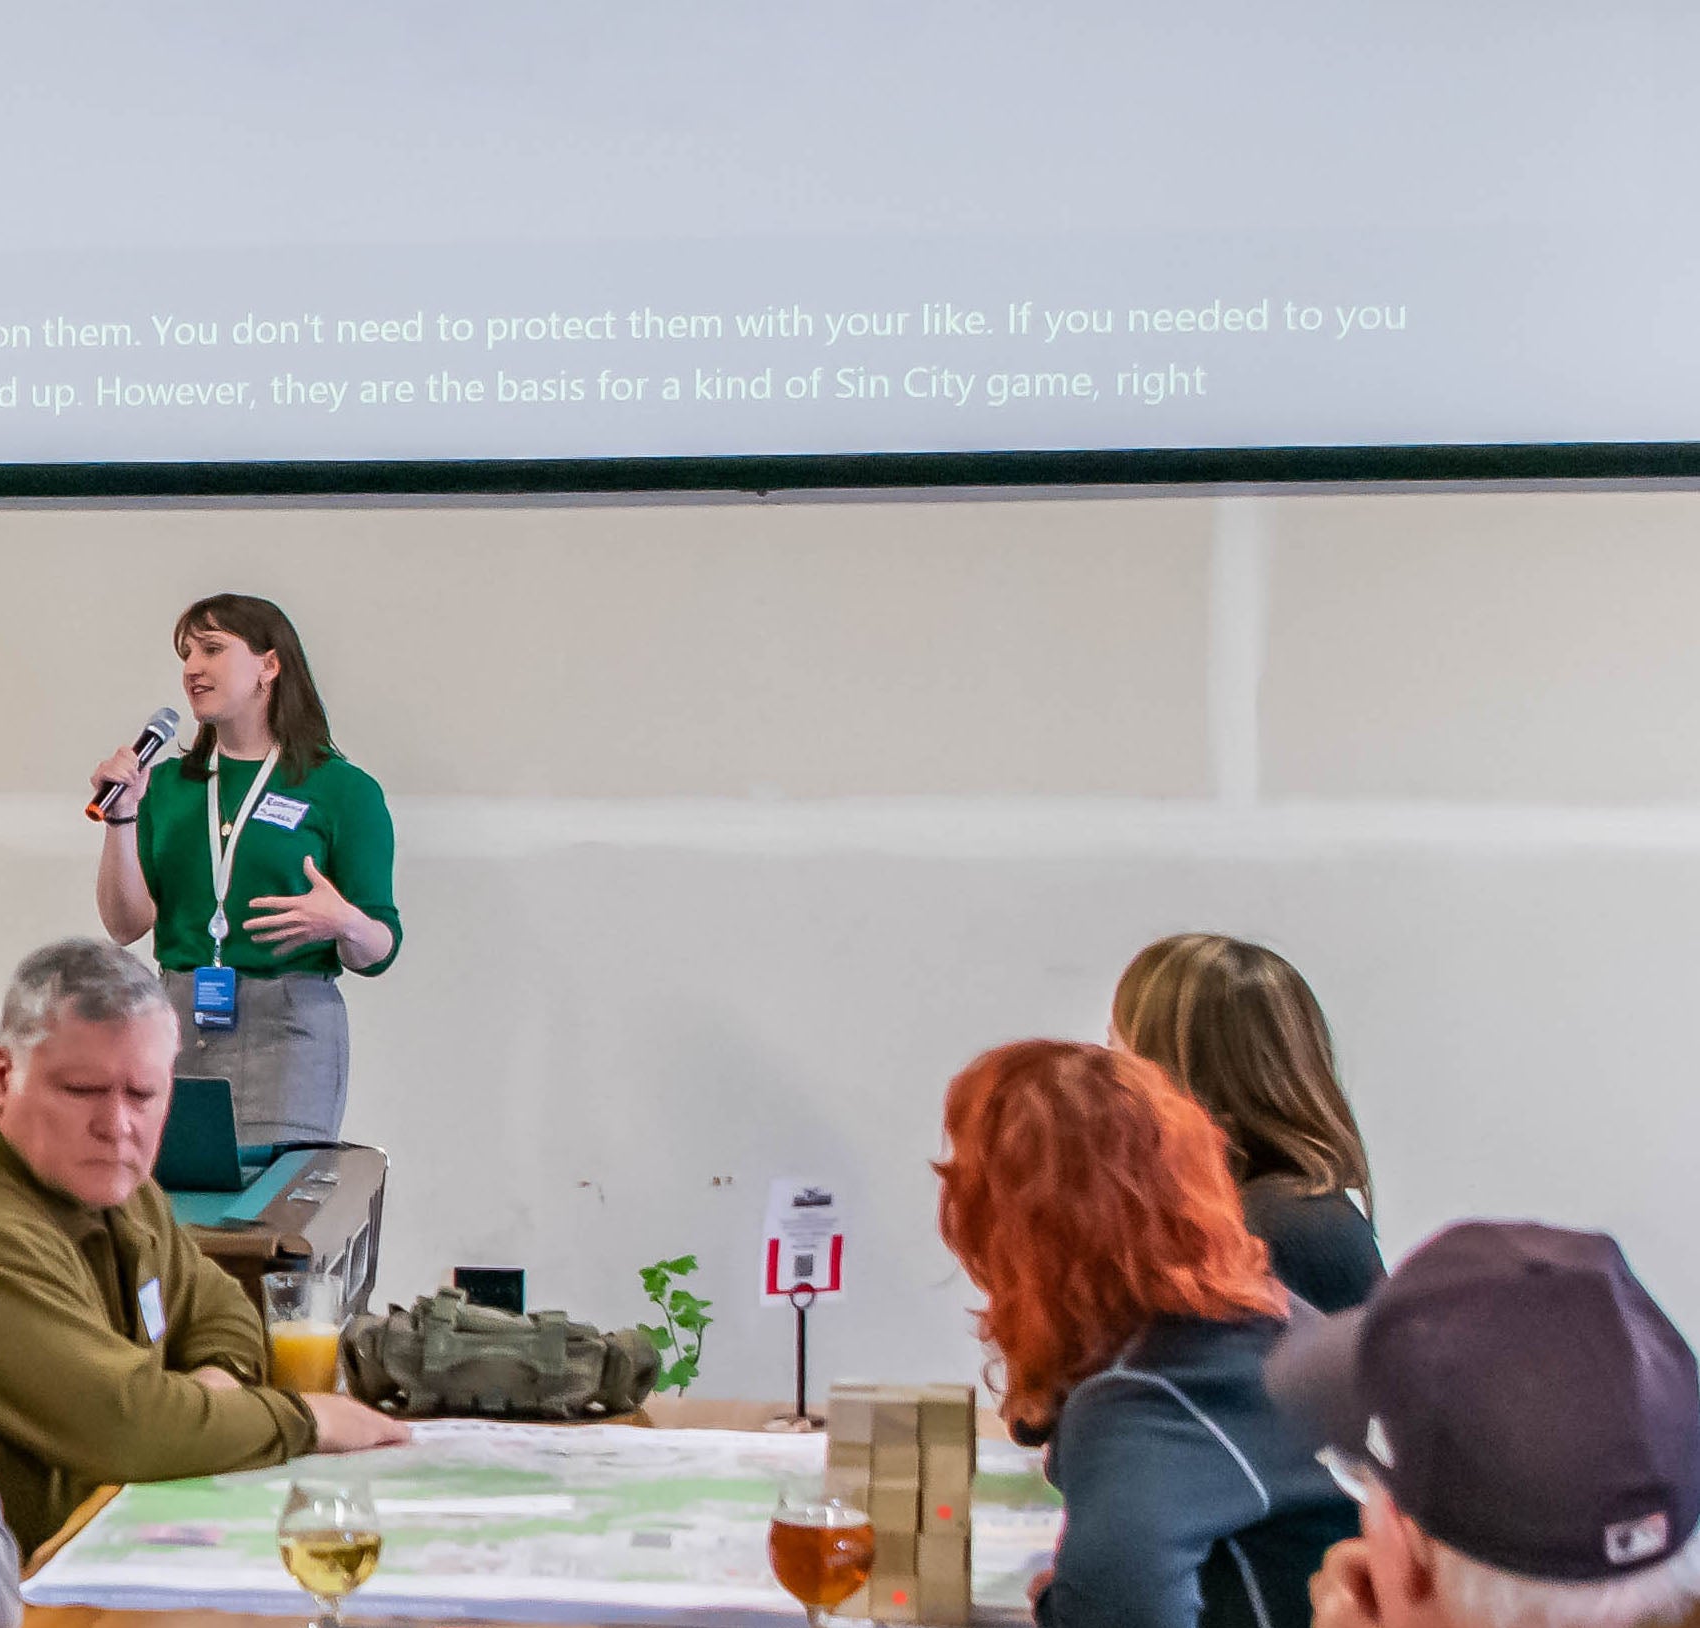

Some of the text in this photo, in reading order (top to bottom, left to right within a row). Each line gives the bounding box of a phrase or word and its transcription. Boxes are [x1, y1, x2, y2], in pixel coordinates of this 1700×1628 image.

[42, 315, 141, 347] them.
[151, 314, 218, 346] You
[232, 312, 324, 345] don't
[337, 310, 424, 343] need
[436, 313, 474, 342] to
[487, 310, 617, 350] protect
[626, 307, 722, 339] them
[735, 304, 814, 338] with
[825, 312, 911, 346] your
[923, 302, 993, 335] like.
[1009, 301, 1033, 335] If
[1044, 309, 1114, 343] you
[1128, 298, 1269, 333] needed
[1283, 300, 1323, 331] to
[1335, 305, 1406, 340] you
[31, 383, 84, 416] up.
[97, 376, 256, 413] However,
[270, 373, 349, 413] they
[359, 380, 415, 404] are
[425, 370, 485, 403] the
[497, 370, 585, 402] basis
[597, 369, 649, 401] for
[661, 377, 681, 400] a
[695, 367, 772, 400] kind
[785, 367, 824, 399] of
[835, 366, 891, 398] Sin
[903, 365, 976, 407] City
[986, 373, 1099, 407] game,
[1117, 363, 1207, 405] right
